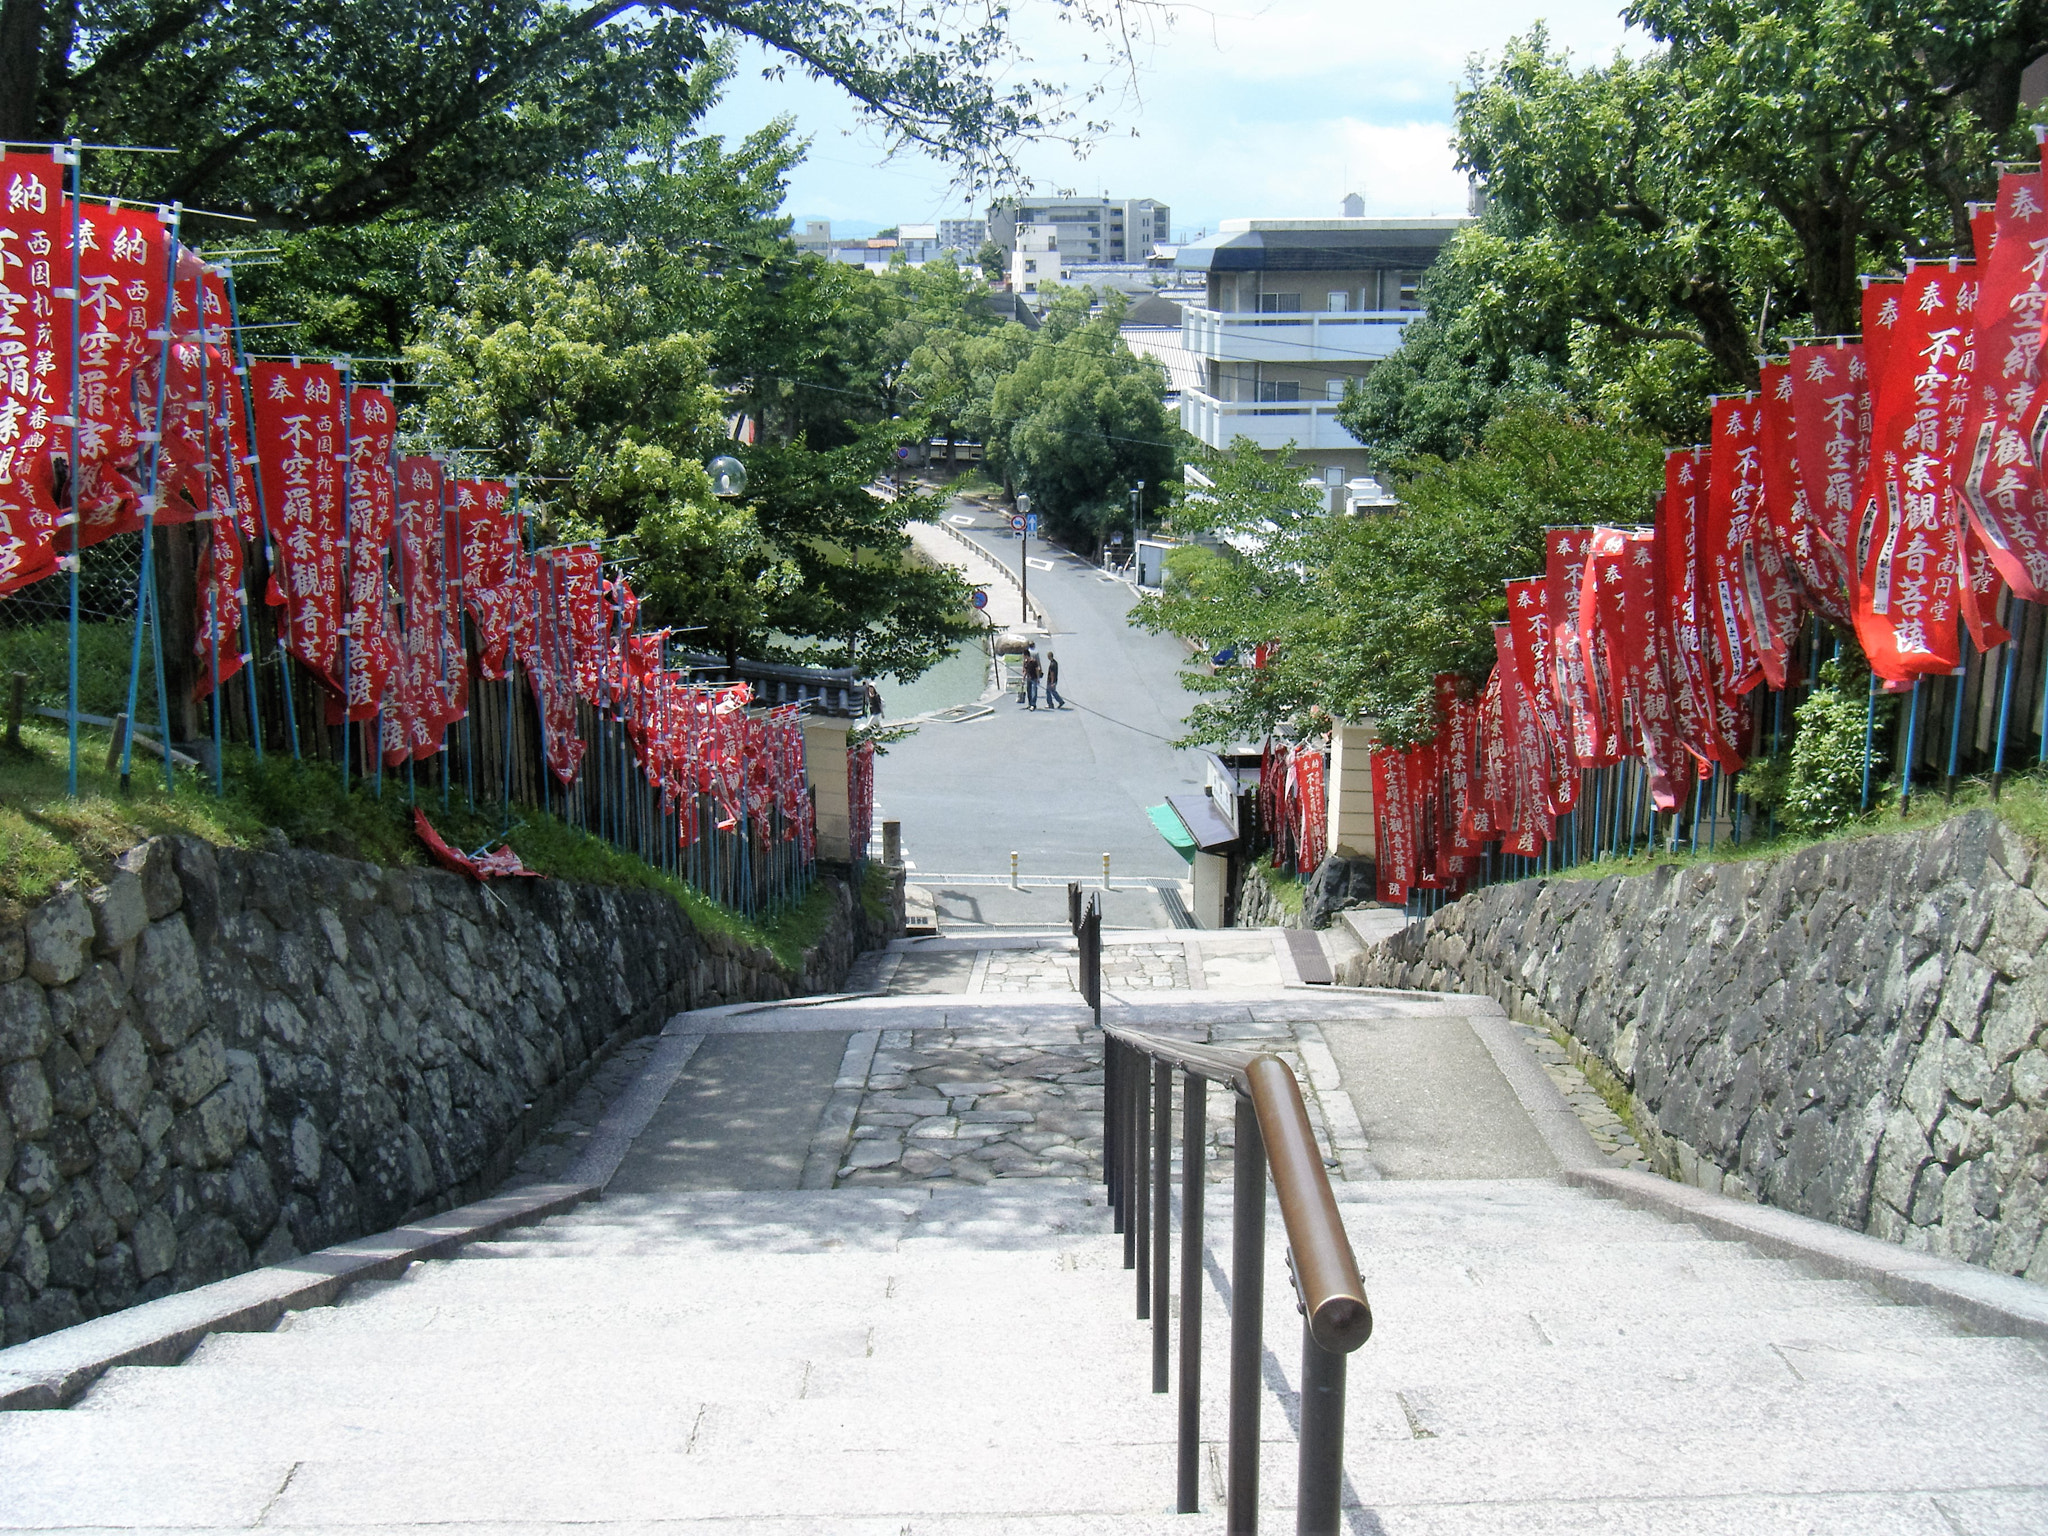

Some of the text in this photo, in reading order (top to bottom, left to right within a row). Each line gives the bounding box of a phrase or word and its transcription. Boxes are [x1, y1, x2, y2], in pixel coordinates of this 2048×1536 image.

[2011, 187, 2042, 223] 奉
[66, 217, 148, 266] 奉納
[1876, 298, 1898, 330] 奉
[1916, 281, 1979, 316] 奉納
[268, 374, 331, 405] 奉納
[1678, 462, 1694, 487] 奉
[1883, 451, 1898, 479] 施主
[459, 488, 504, 511] 奉納
[1893, 327, 1961, 655] 不空羂索観音菩薩
[1633, 547, 1652, 568] 奉
[1604, 565, 1622, 585] 奉
